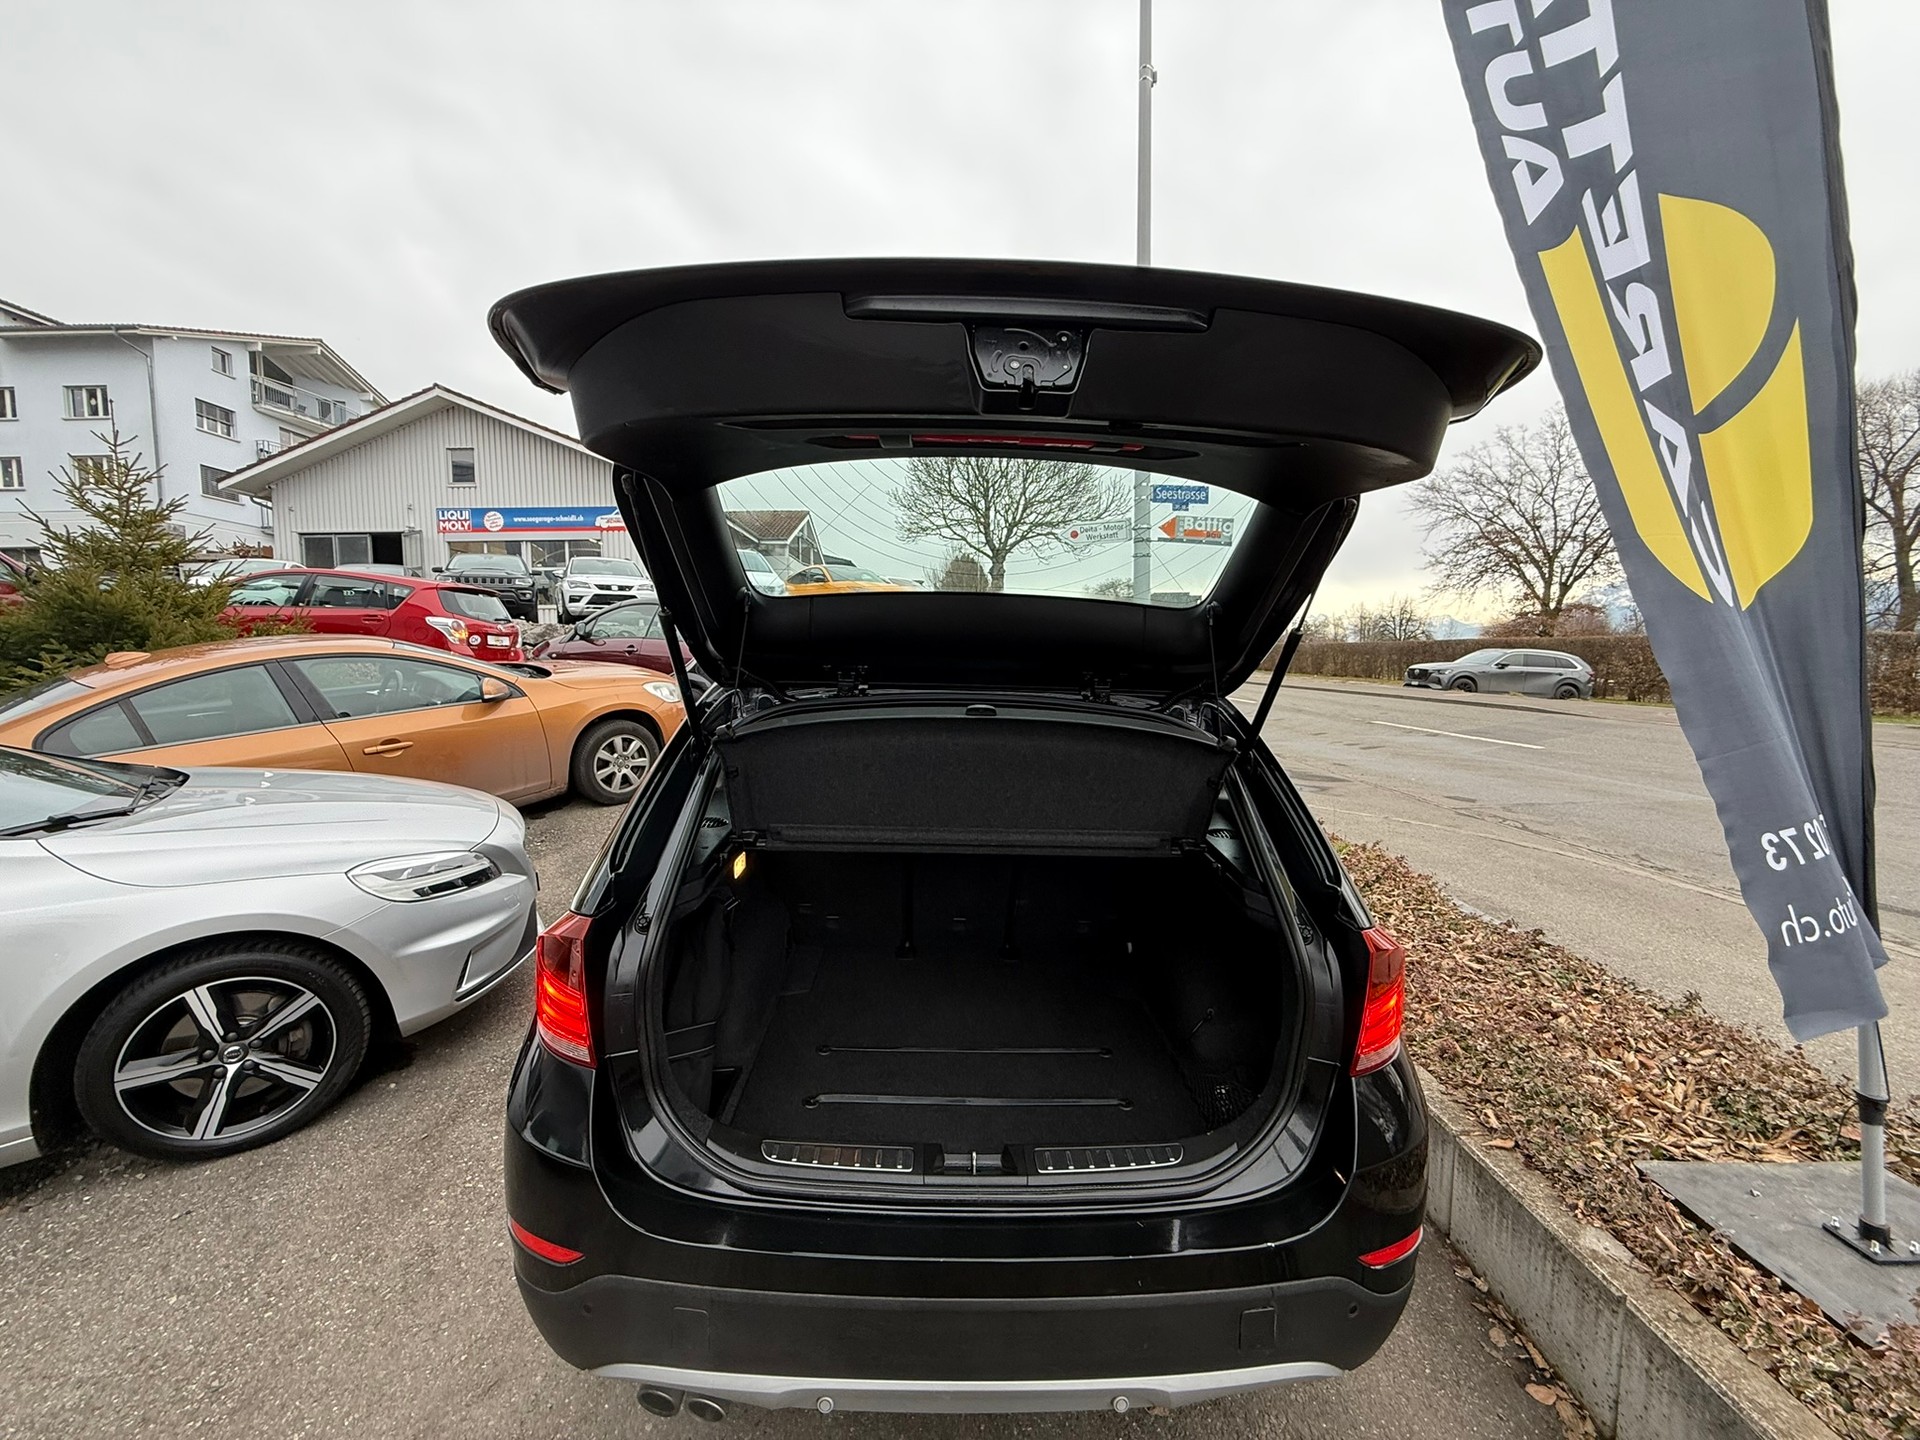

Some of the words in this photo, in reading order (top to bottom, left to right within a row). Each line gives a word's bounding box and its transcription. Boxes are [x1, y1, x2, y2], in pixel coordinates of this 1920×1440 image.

[1155, 487, 1207, 500] Seestrasse
[438, 510, 470, 520] LIQUI
[439, 521, 470, 531] MOLY
[1184, 516, 1233, 537] Bättig
[1085, 531, 1119, 541] Werkstatt
